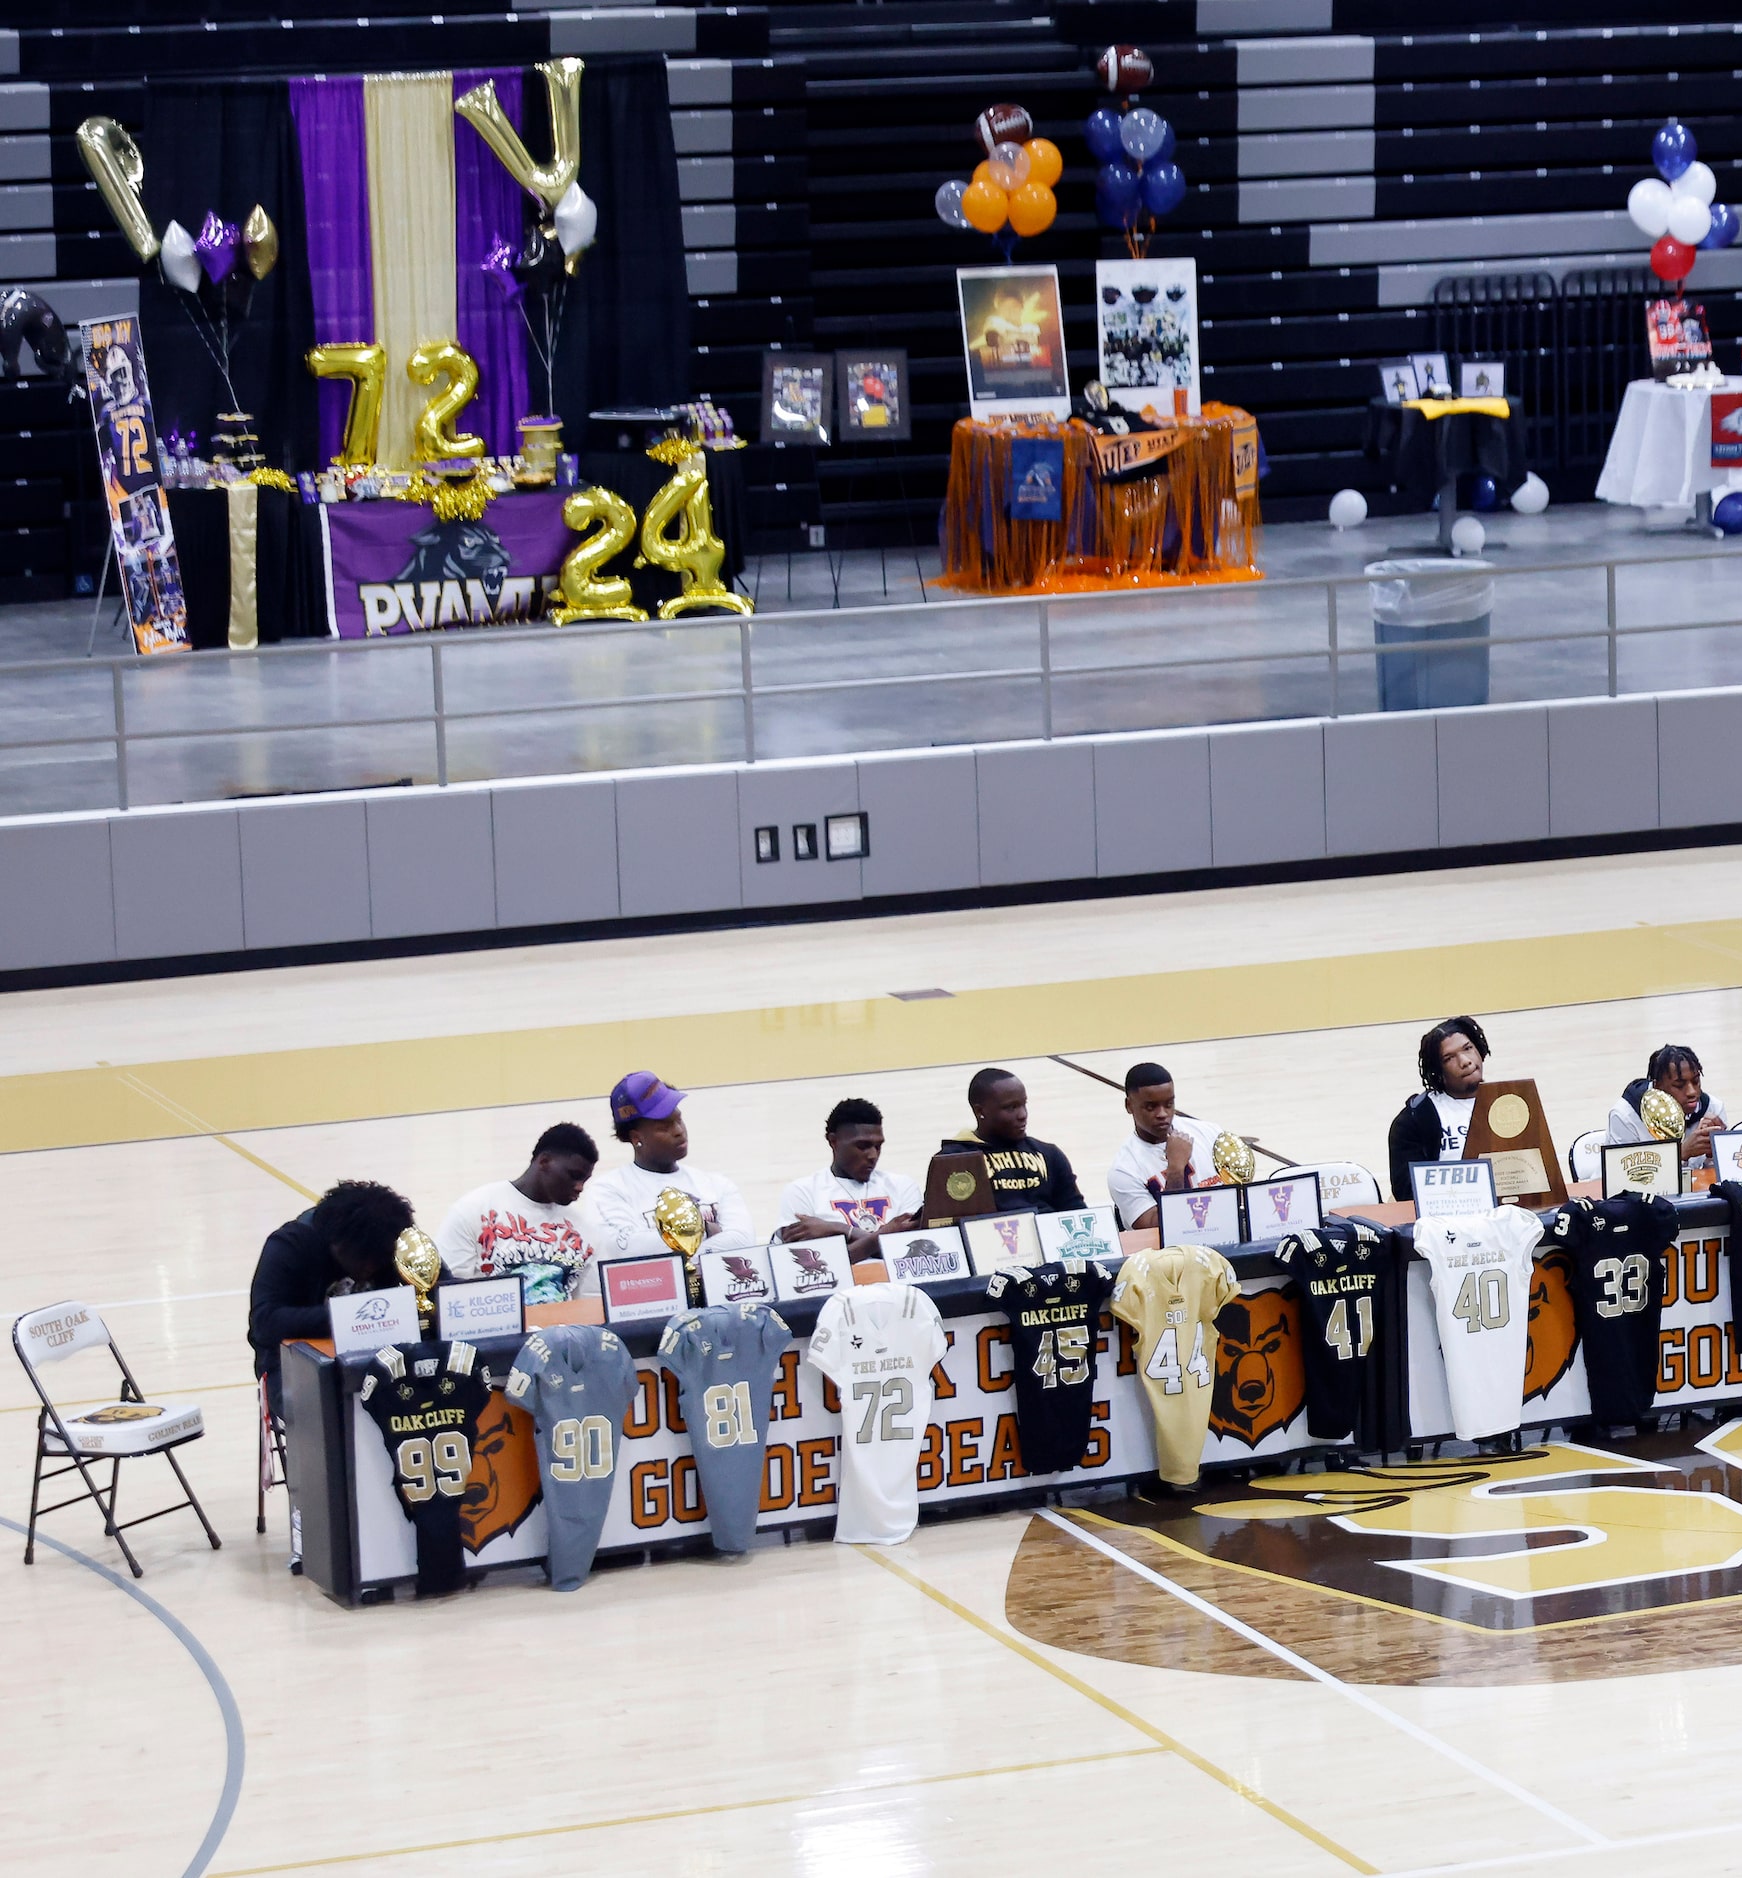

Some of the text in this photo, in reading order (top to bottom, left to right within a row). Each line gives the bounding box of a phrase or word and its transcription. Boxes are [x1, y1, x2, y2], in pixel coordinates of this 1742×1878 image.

[116, 417, 154, 477] 72
[1620, 1152, 1662, 1170] TYLER
[1330, 1173, 1362, 1187] OAK
[1424, 1166, 1479, 1186] ETBU
[893, 1251, 961, 1280] PVAMU
[1447, 1250, 1506, 1269] THE MECCA
[728, 1279, 767, 1294] ULM
[797, 1270, 835, 1287] ULM
[1310, 1274, 1377, 1296] OAK CLIFF
[1593, 1253, 1650, 1319] 33
[469, 1292, 516, 1307] KILGORE
[470, 1303, 516, 1318] COLLEGE
[1452, 1268, 1511, 1334] 40
[29, 1310, 90, 1339] SOUTH OAK
[378, 1318, 400, 1328] TECH
[1021, 1304, 1088, 1327] OAK CLIFF
[47, 1328, 75, 1348] CLIFF
[1325, 1296, 1374, 1360] 41
[852, 1356, 915, 1375] THE MECCA
[1032, 1325, 1090, 1390] 45
[1145, 1320, 1211, 1396] 44
[390, 1409, 466, 1434] OAK CLIFF
[703, 1380, 758, 1448] 81
[852, 1377, 915, 1444] 72
[148, 1422, 182, 1442] GOLDEN
[550, 1415, 614, 1482] 90
[397, 1431, 473, 1502] 99
